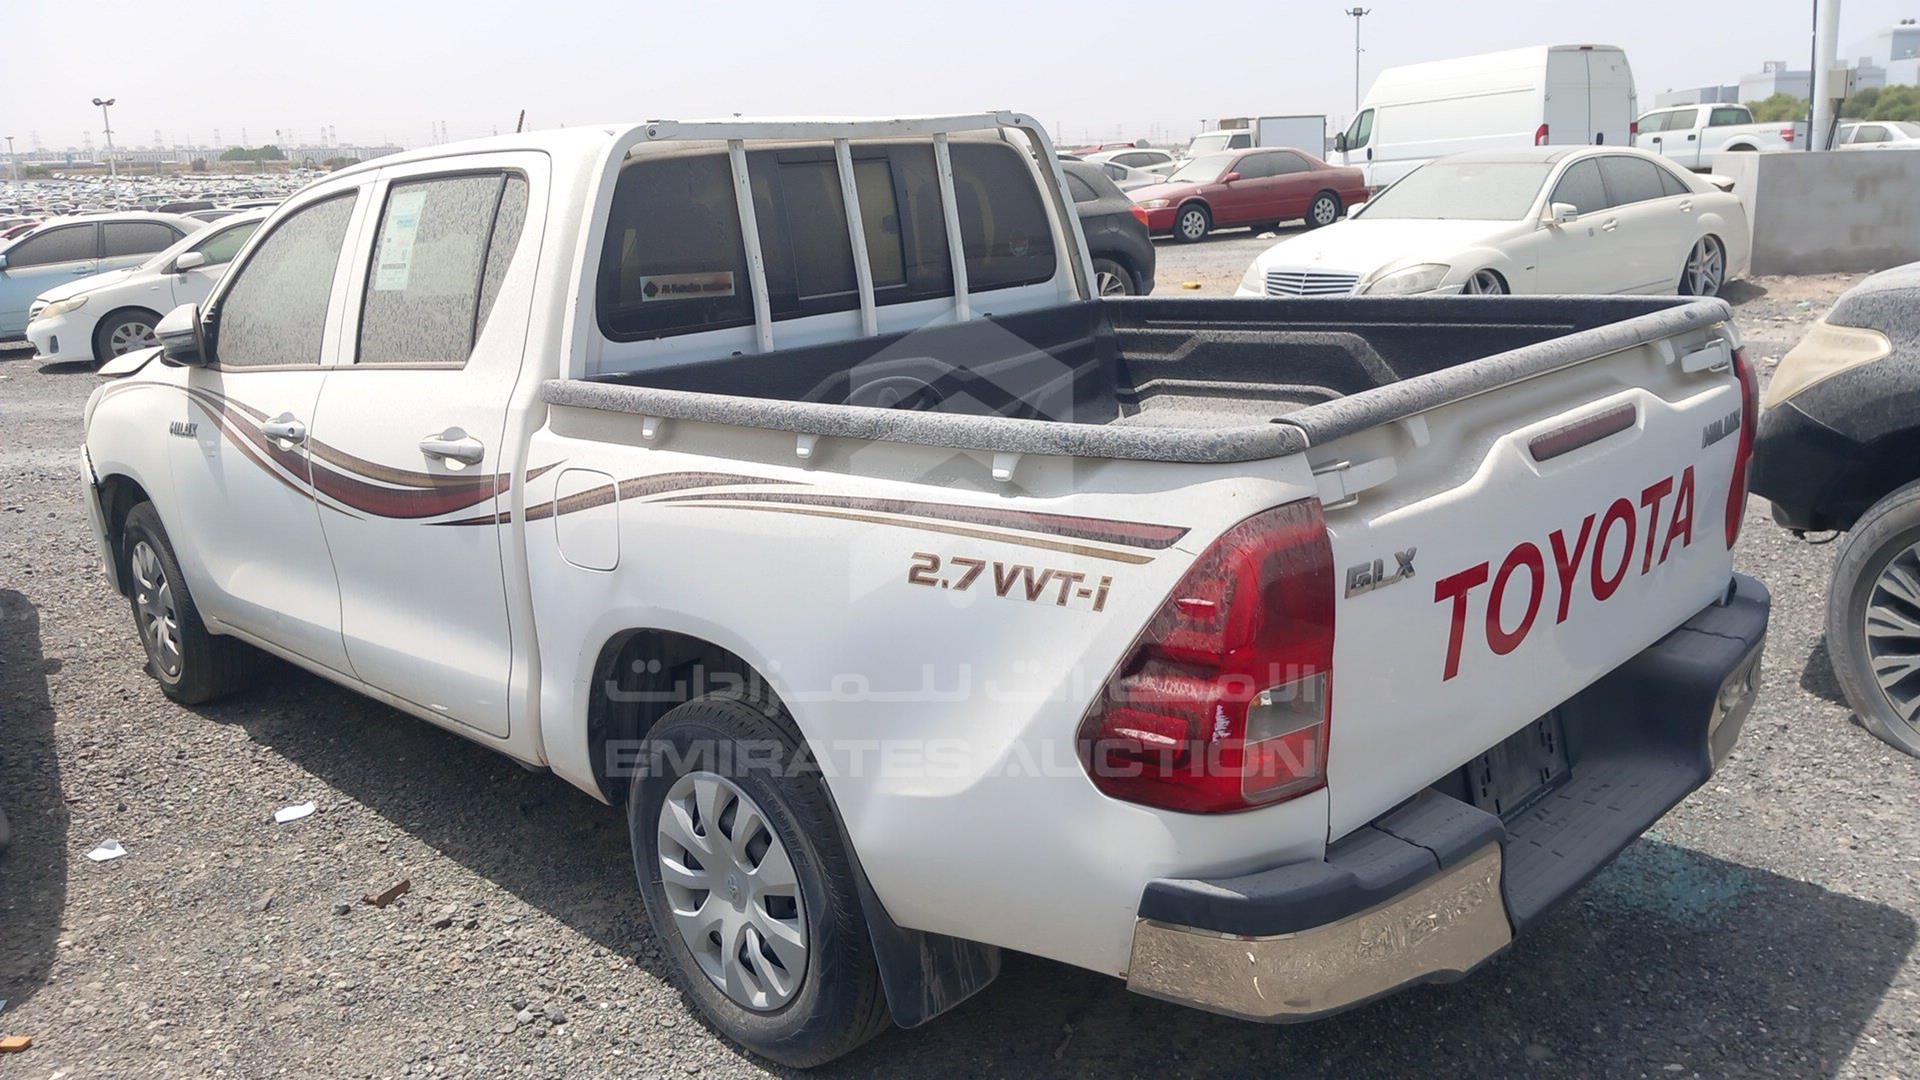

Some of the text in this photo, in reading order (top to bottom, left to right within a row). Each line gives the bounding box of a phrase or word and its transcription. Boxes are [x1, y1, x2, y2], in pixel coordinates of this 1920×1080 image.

[908, 552, 1113, 612] 2.7 VVT-i
[1344, 547, 1417, 599] GLX
[1434, 465, 1695, 682] TOYOTA
